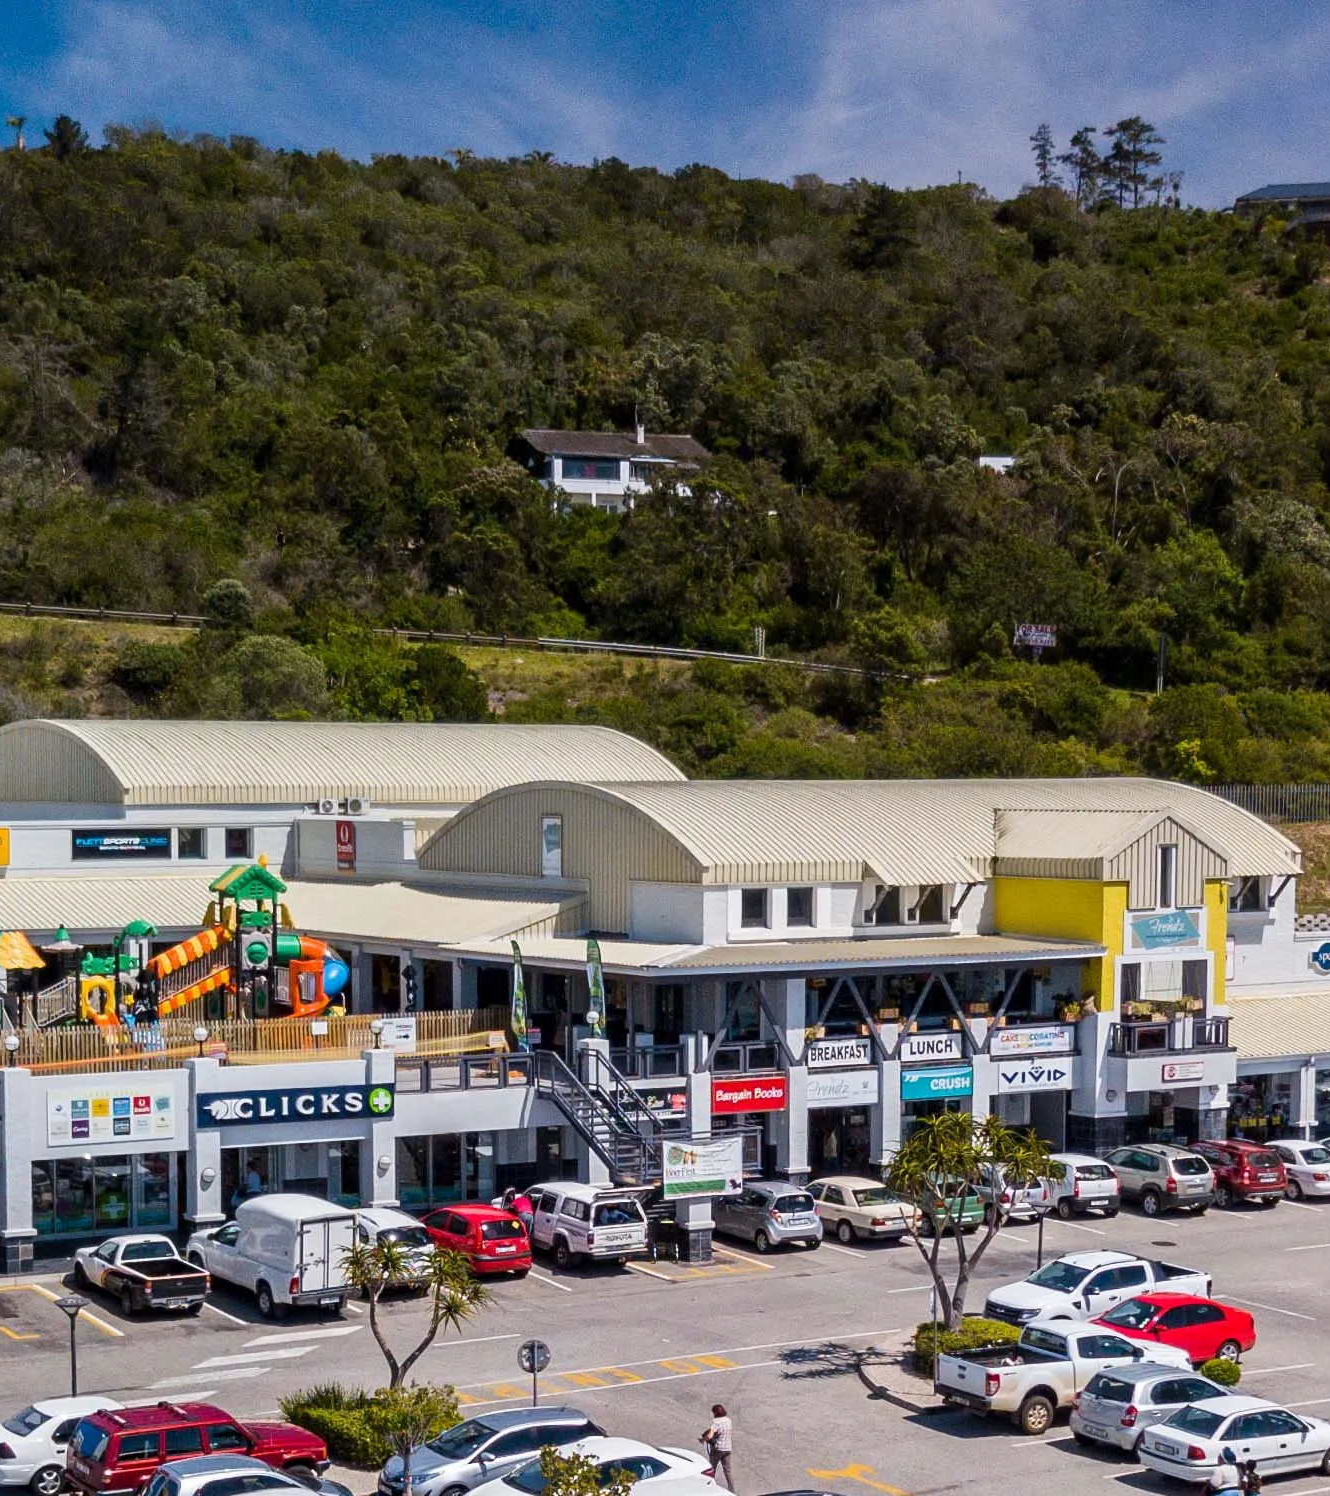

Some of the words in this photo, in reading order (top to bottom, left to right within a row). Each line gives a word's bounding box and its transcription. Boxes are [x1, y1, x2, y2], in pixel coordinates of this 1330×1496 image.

[810, 1044, 869, 1061] BREAKFAST
[909, 1039, 954, 1056] LUNCH
[930, 1076, 971, 1091] CRUSH
[1001, 1068, 1067, 1084] VIVID
[715, 1087, 752, 1103] Bargain
[754, 1086, 783, 1099] Books
[235, 1092, 363, 1119] CLICKS
